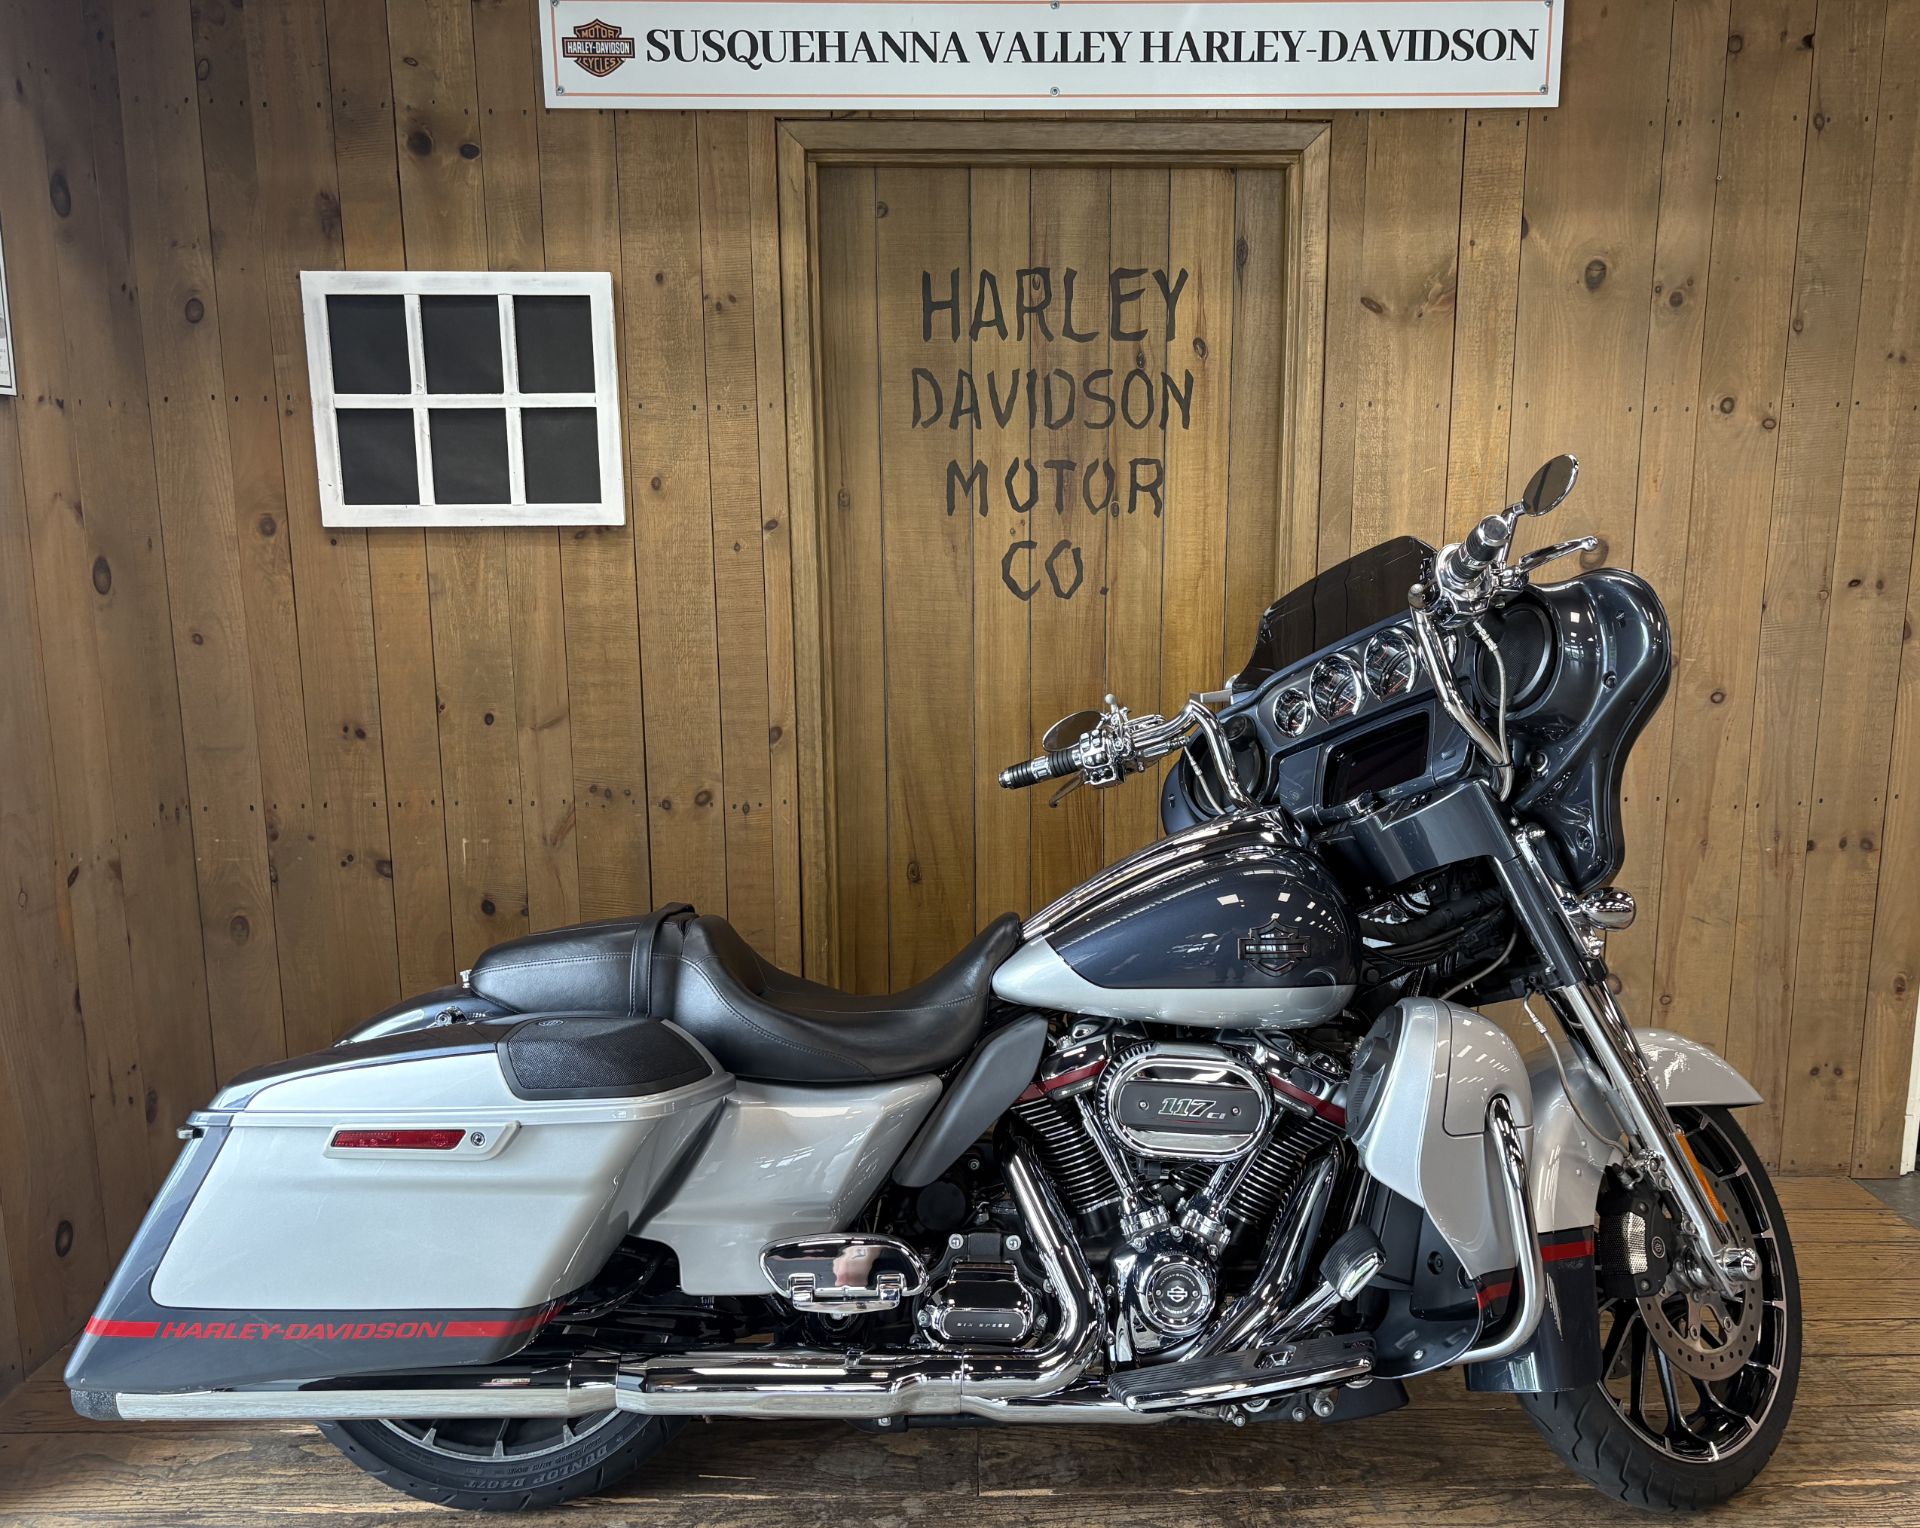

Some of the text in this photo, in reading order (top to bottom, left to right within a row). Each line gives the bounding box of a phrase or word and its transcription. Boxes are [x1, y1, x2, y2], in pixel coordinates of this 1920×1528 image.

[567, 41, 630, 54] HARLEY-DAVIDSON
[581, 25, 615, 38] MOTOR
[646, 28, 1540, 70] SUSQUEHANNA VALLEY HARLEY-DAVIDSON
[581, 57, 616, 73] CYCLES
[922, 267, 1189, 343] HARLEY
[911, 367, 1194, 430] DAVIDSON
[946, 457, 1163, 518] MOTOR
[160, 1321, 443, 1341] HARLEY-DAVIDSON
[533, 1445, 608, 1485] DUNLOP
